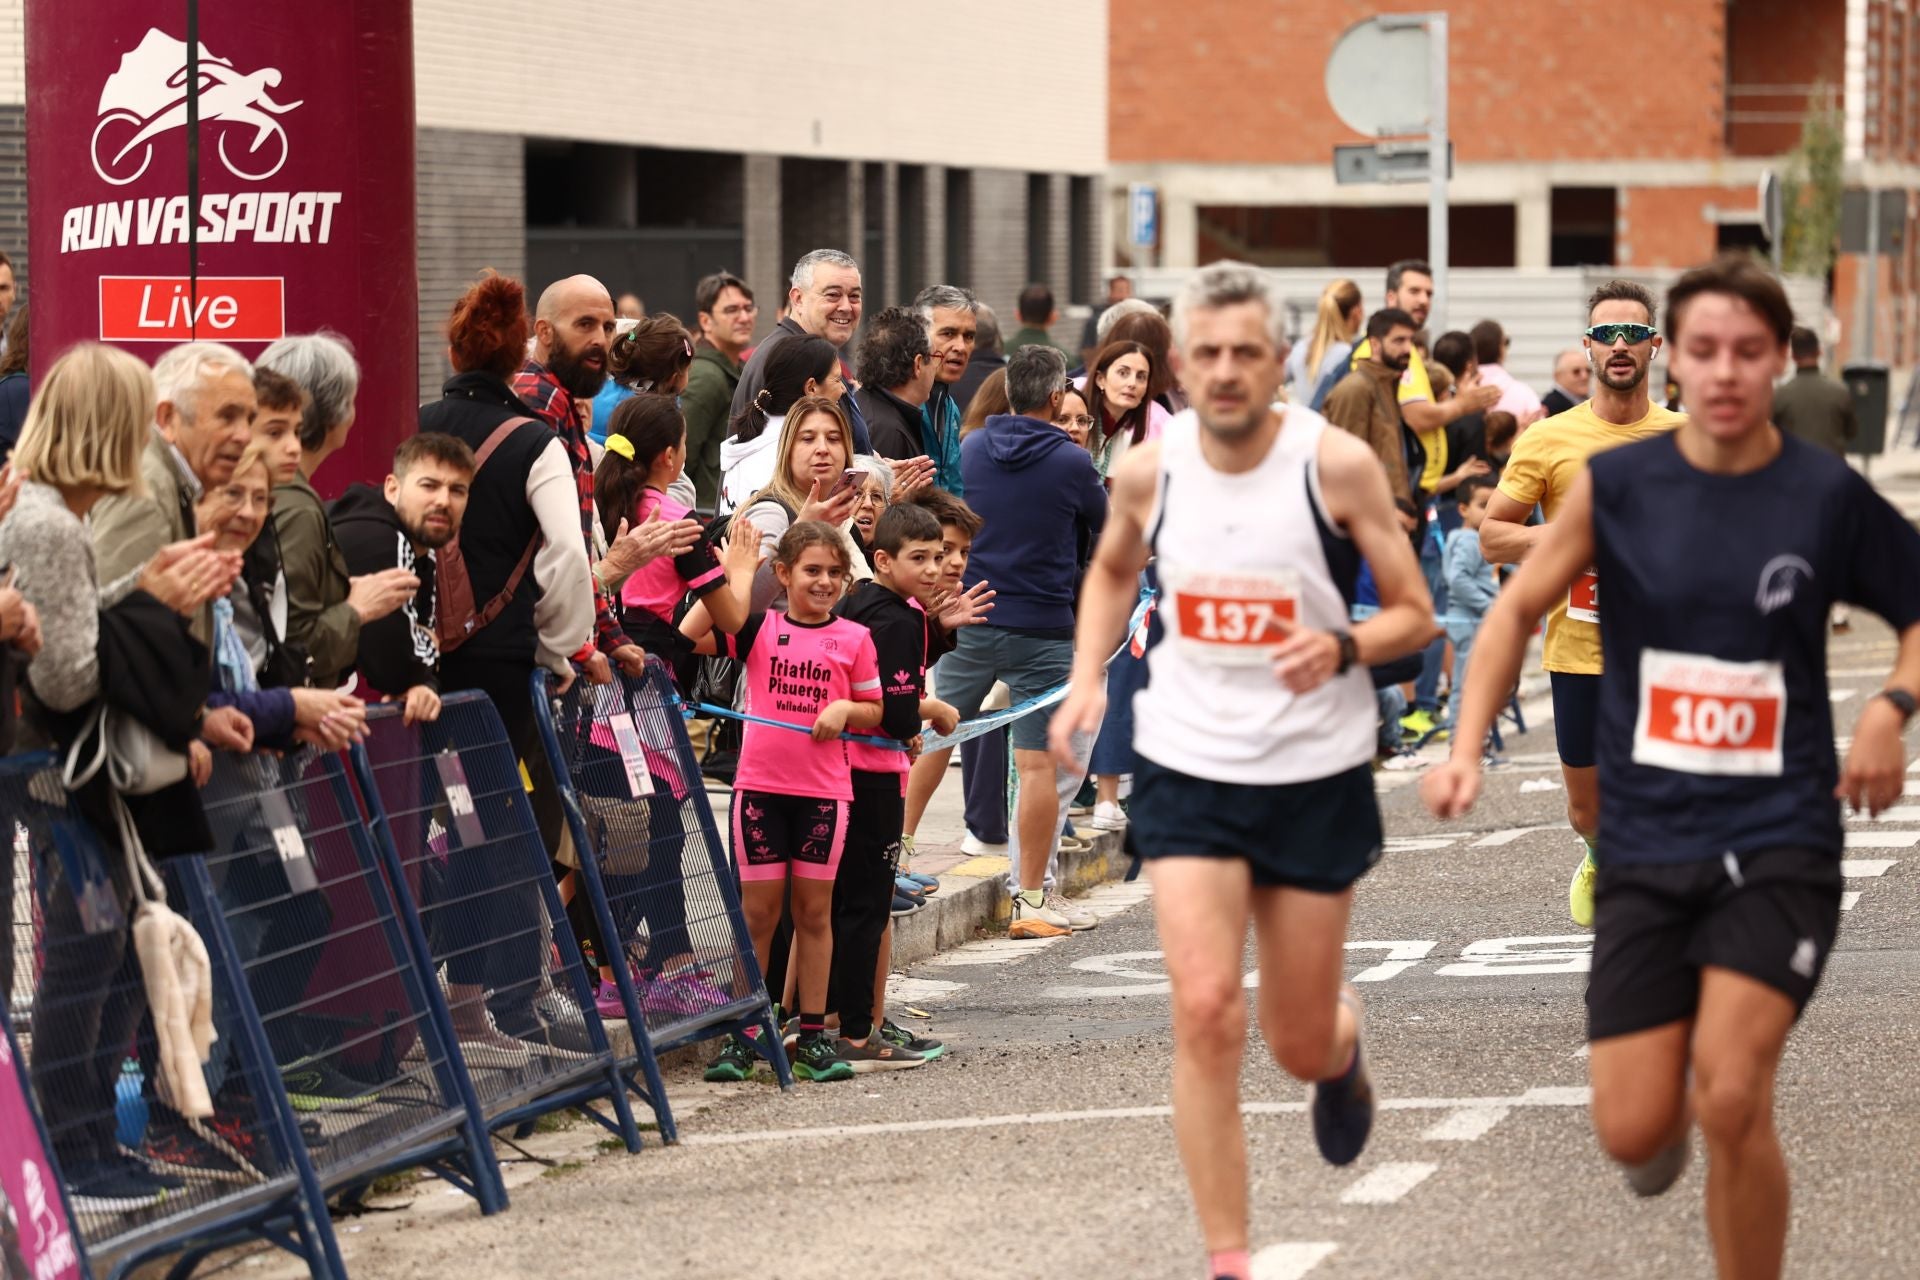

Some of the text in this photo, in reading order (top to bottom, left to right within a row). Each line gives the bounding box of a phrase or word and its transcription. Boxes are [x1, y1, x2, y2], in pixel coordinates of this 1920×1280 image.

[137, 284, 239, 330] Live
[1194, 600, 1273, 642] 137
[769, 655, 832, 683] Triatlón
[768, 676, 829, 703] Pisuerga
[776, 699, 819, 715] Valladolid
[1670, 694, 1757, 747] 100
